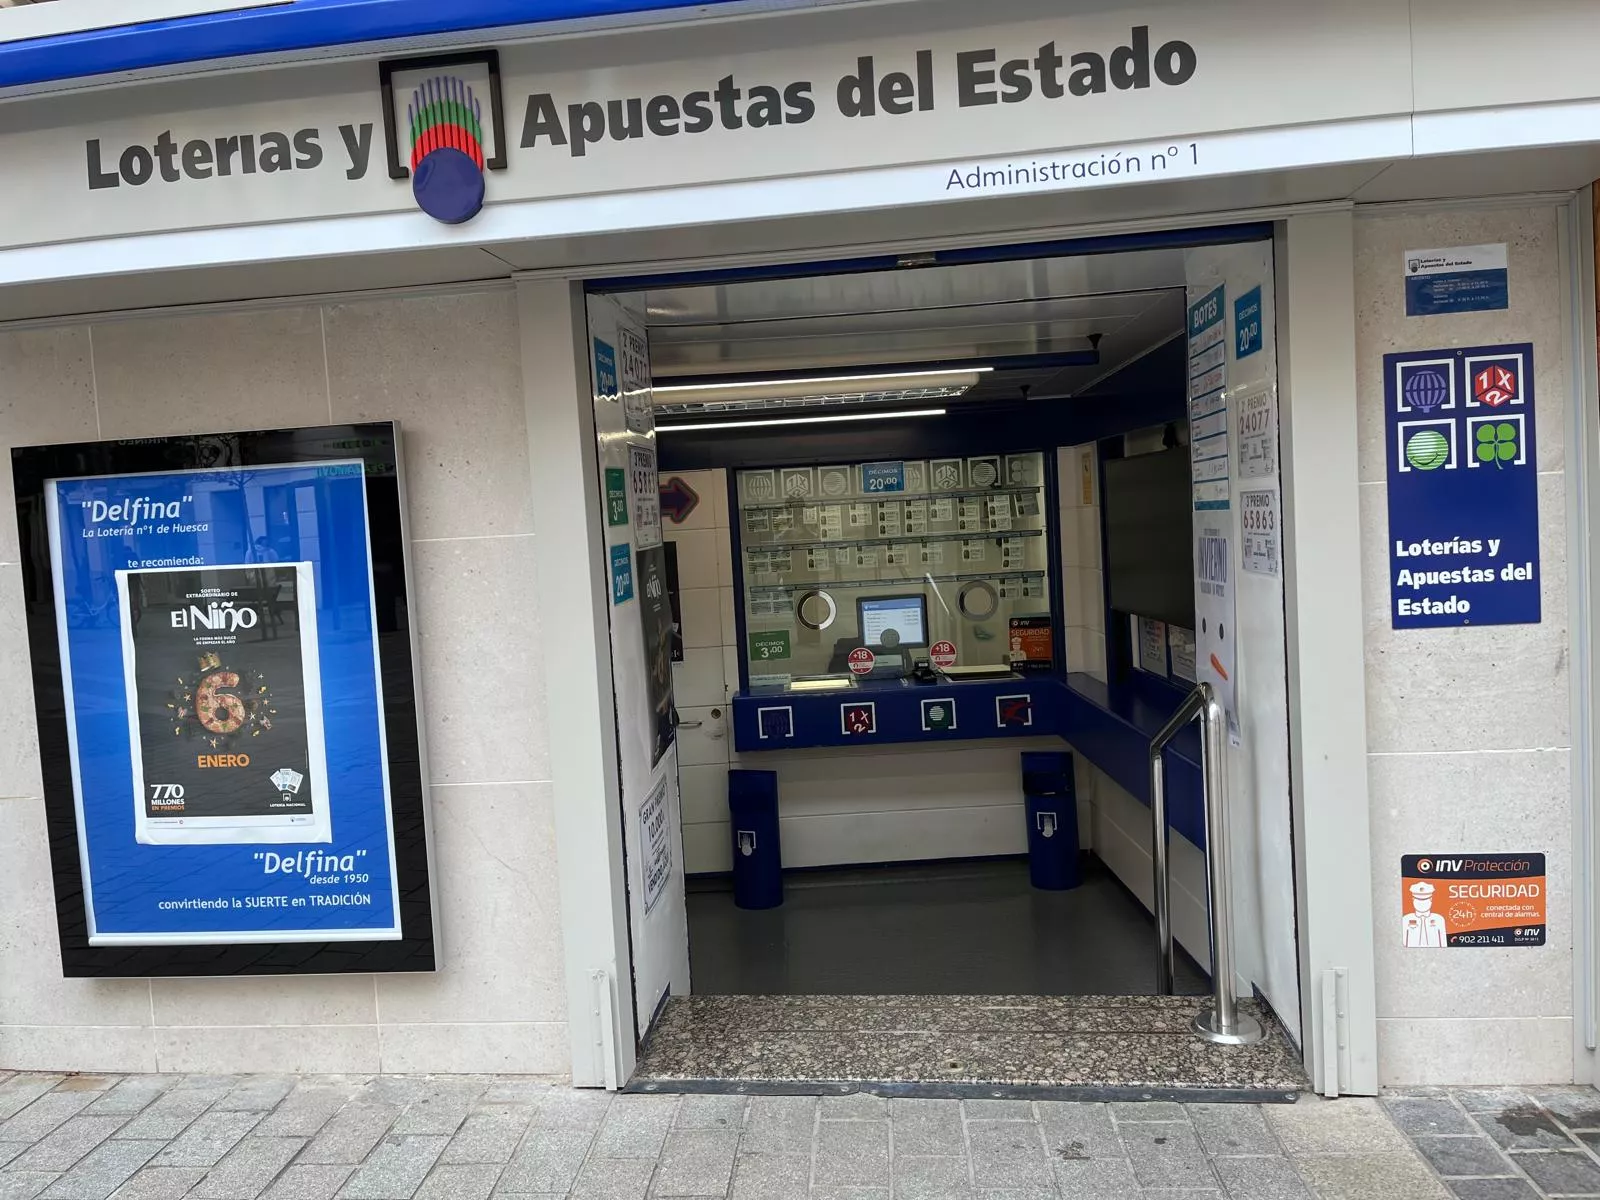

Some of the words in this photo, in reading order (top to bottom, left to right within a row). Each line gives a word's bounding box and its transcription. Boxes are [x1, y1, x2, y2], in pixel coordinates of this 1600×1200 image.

[520, 74, 815, 157] Apuestas
[836, 49, 934, 118] del
[956, 25, 1197, 109] Estado
[338, 123, 373, 180] y
[946, 151, 1141, 190] Administración
[1151, 146, 1178, 170] nº
[1189, 143, 1198, 165] 1
[1194, 296, 1217, 328] BOTES
[1240, 408, 1270, 435] 24077
[82, 496, 192, 526] "Delfina"
[1243, 510, 1274, 530] 65863
[82, 528, 94, 538] La
[157, 524, 170, 534] de
[172, 523, 209, 533] Huesca
[1396, 536, 1482, 557] Loterías
[1488, 538, 1500, 557] y
[127, 560, 139, 568] te
[141, 555, 205, 567] recomienda:
[1397, 566, 1495, 590] Apuestas
[1500, 562, 1533, 581] del
[1398, 595, 1470, 616] Estado
[189, 601, 258, 632] Niño
[1010, 628, 1049, 637] SEGURIDAD
[852, 650, 868, 660] +18
[935, 643, 950, 653] +18
[197, 754, 250, 768] ENERO
[150, 784, 185, 799] 770
[253, 850, 367, 879] "Delfina"
[1435, 859, 1463, 871] INV
[1463, 859, 1530, 871] Protección
[310, 874, 340, 885] desde
[343, 873, 369, 884] 1950
[158, 897, 228, 910] convirtiendo
[232, 896, 242, 908] la
[245, 896, 288, 908] SUERTE
[292, 898, 306, 907] en
[309, 891, 371, 907] TRADICIÓN
[1448, 884, 1540, 899] SEGURIDAD
[1480, 910, 1504, 918] central
[1459, 935, 1476, 944] 902
[1477, 935, 1490, 943] 211
[1491, 935, 1505, 943] 411
